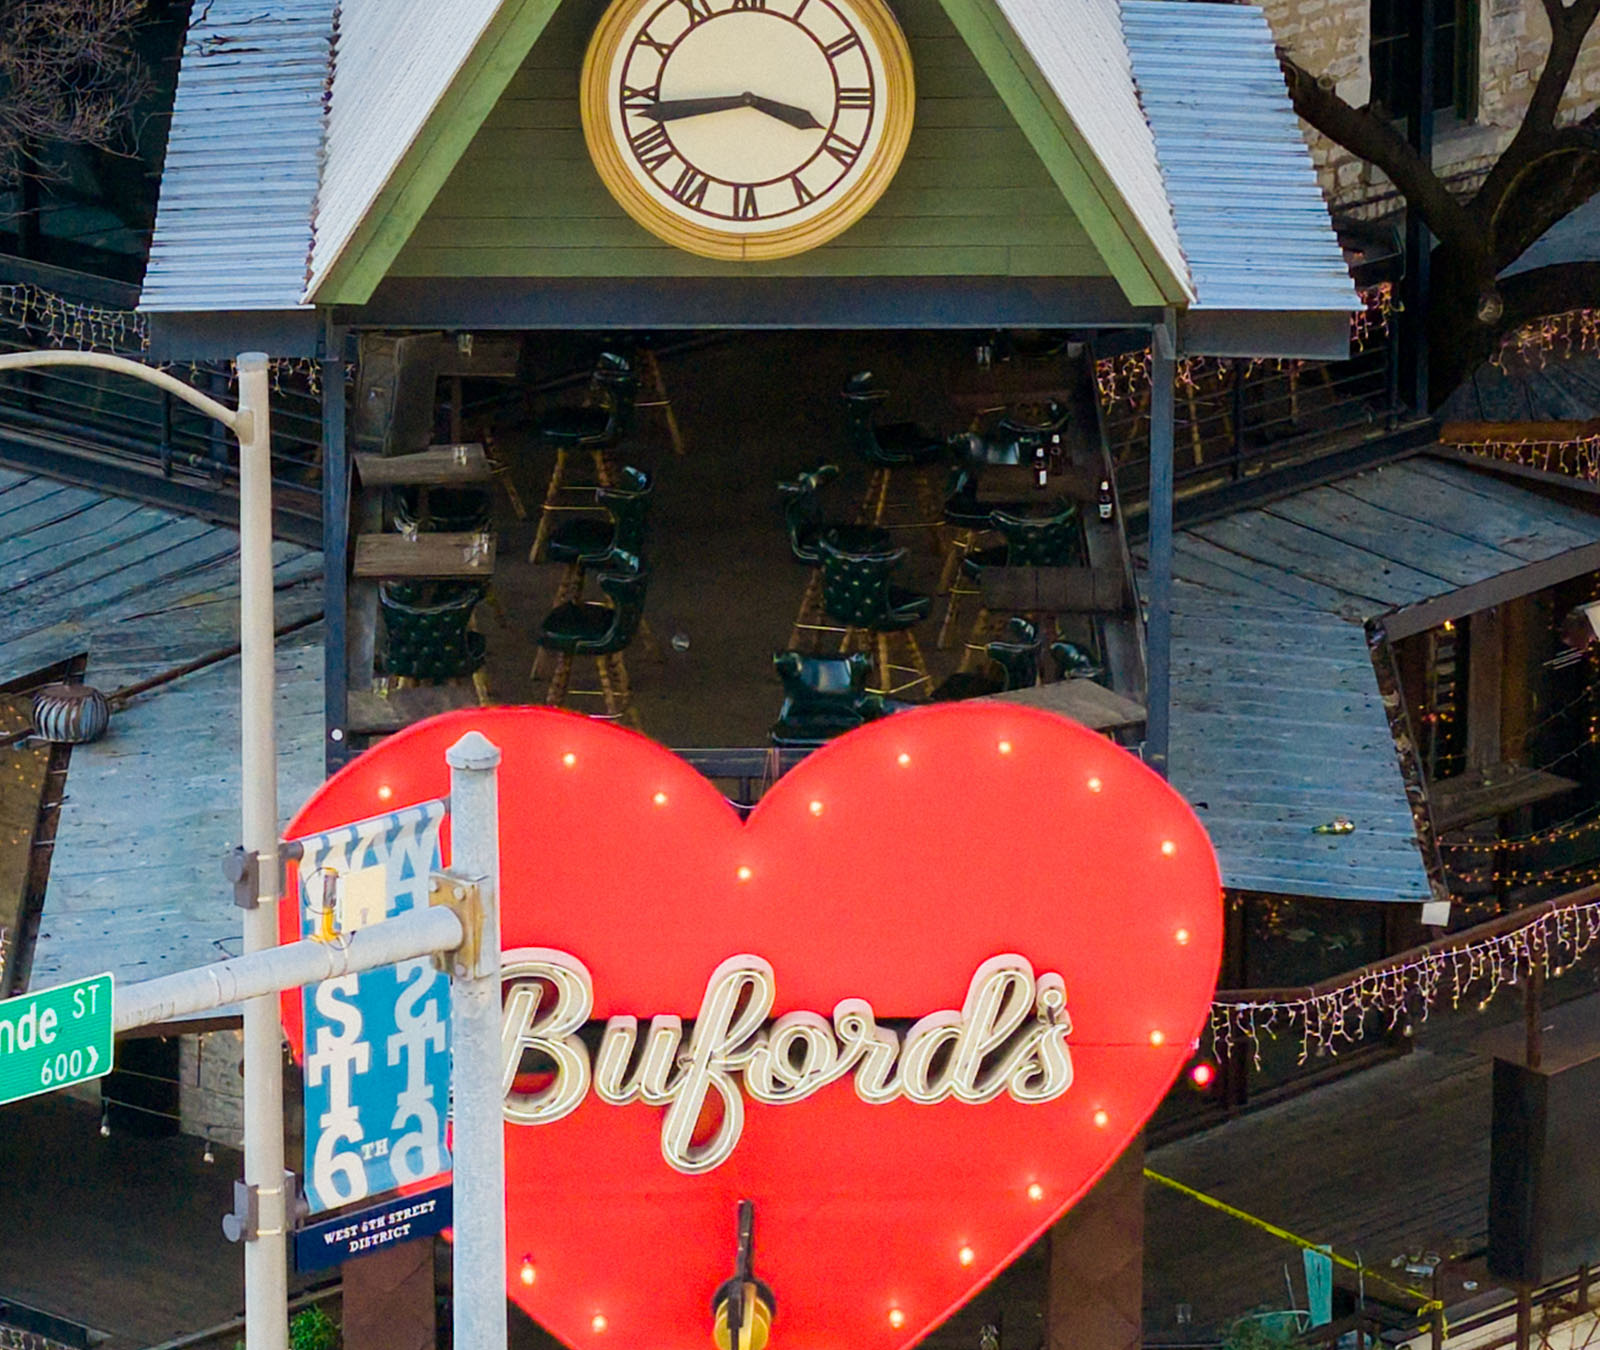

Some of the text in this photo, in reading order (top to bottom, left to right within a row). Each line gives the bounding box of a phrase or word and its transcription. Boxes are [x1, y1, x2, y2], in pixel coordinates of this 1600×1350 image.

[72, 984, 100, 1019] ST
[40, 1049, 82, 1085] 600
[500, 947, 1072, 1174] Buford's
[323, 1224, 358, 1245] WEST
[388, 1200, 437, 1225] STREET
[349, 1223, 412, 1252] DISTRICT
